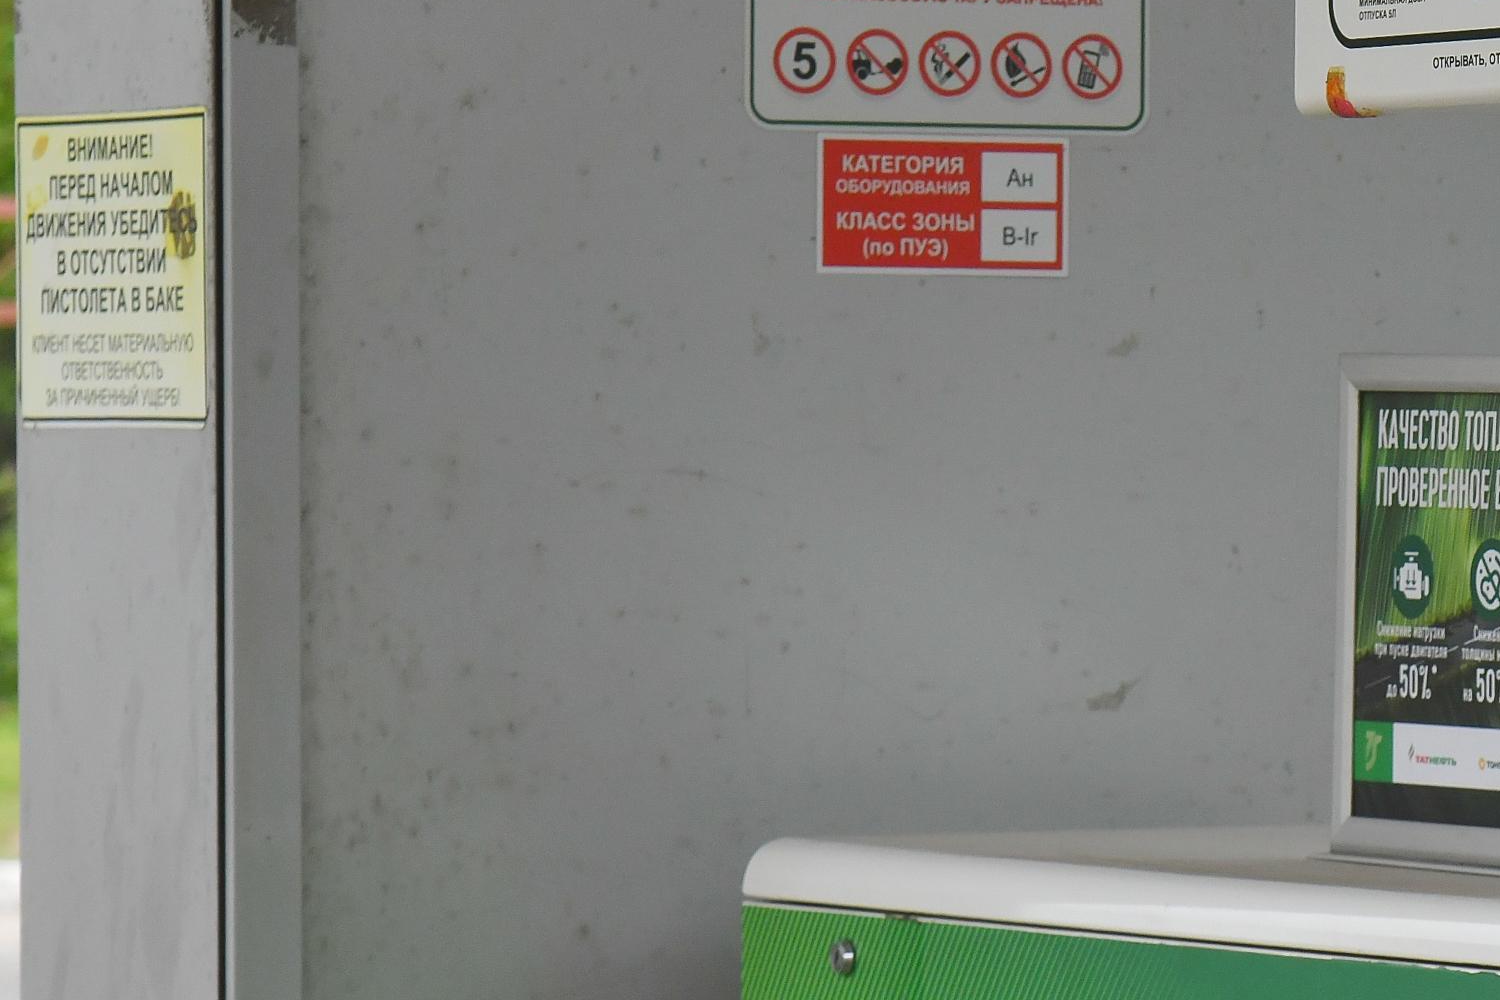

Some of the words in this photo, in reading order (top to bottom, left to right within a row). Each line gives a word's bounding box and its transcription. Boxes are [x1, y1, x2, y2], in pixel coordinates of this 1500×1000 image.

[1359, 10, 1387, 21] ОТПУСКА
[792, 41, 817, 80] 5
[1433, 54, 1487, 69] ОТКРЫВАТЬ,
[67, 134, 153, 162] ВНИМАНИЕ!
[842, 154, 964, 175] КАТЕГОРИЯ
[49, 174, 96, 202] ПЕРЕД
[100, 170, 173, 198] НАЧАЛОМ
[835, 179, 971, 196] ОБОРУДОВАНИЯ
[26, 209, 106, 243] ДВИЖЕНИЯ
[836, 211, 907, 232] КЛАСС
[912, 212, 975, 232] ЗОНЫ
[862, 237, 894, 258] (по
[899, 238, 949, 260] ПУЭ)
[57, 251, 66, 275] В
[70, 247, 167, 276] ОТСУТСТВИИ
[40, 287, 126, 315] ПИСТОЛЕТА
[132, 287, 140, 312] В
[146, 286, 184, 312] БАКЕ
[32, 334, 69, 354] КЛИЕНТ
[72, 333, 105, 353] НЕСЕТ
[108, 332, 193, 352] МАТЕРИАЛЬНУЮ
[61, 360, 164, 381] ОТВЕТСТВЕННОСТЬ
[46, 388, 57, 407] ЗА
[1378, 408, 1459, 450] КАЧЕСТВО
[1376, 466, 1490, 510] ПРОВЕРЕННОЕ
[1377, 620, 1412, 639] Снижение
[1413, 625, 1445, 642] нагрузки
[1410, 646, 1448, 659] двигателя
[1461, 648, 1495, 662] толщины
[1386, 684, 1397, 698] до
[1463, 688, 1472, 702] на
